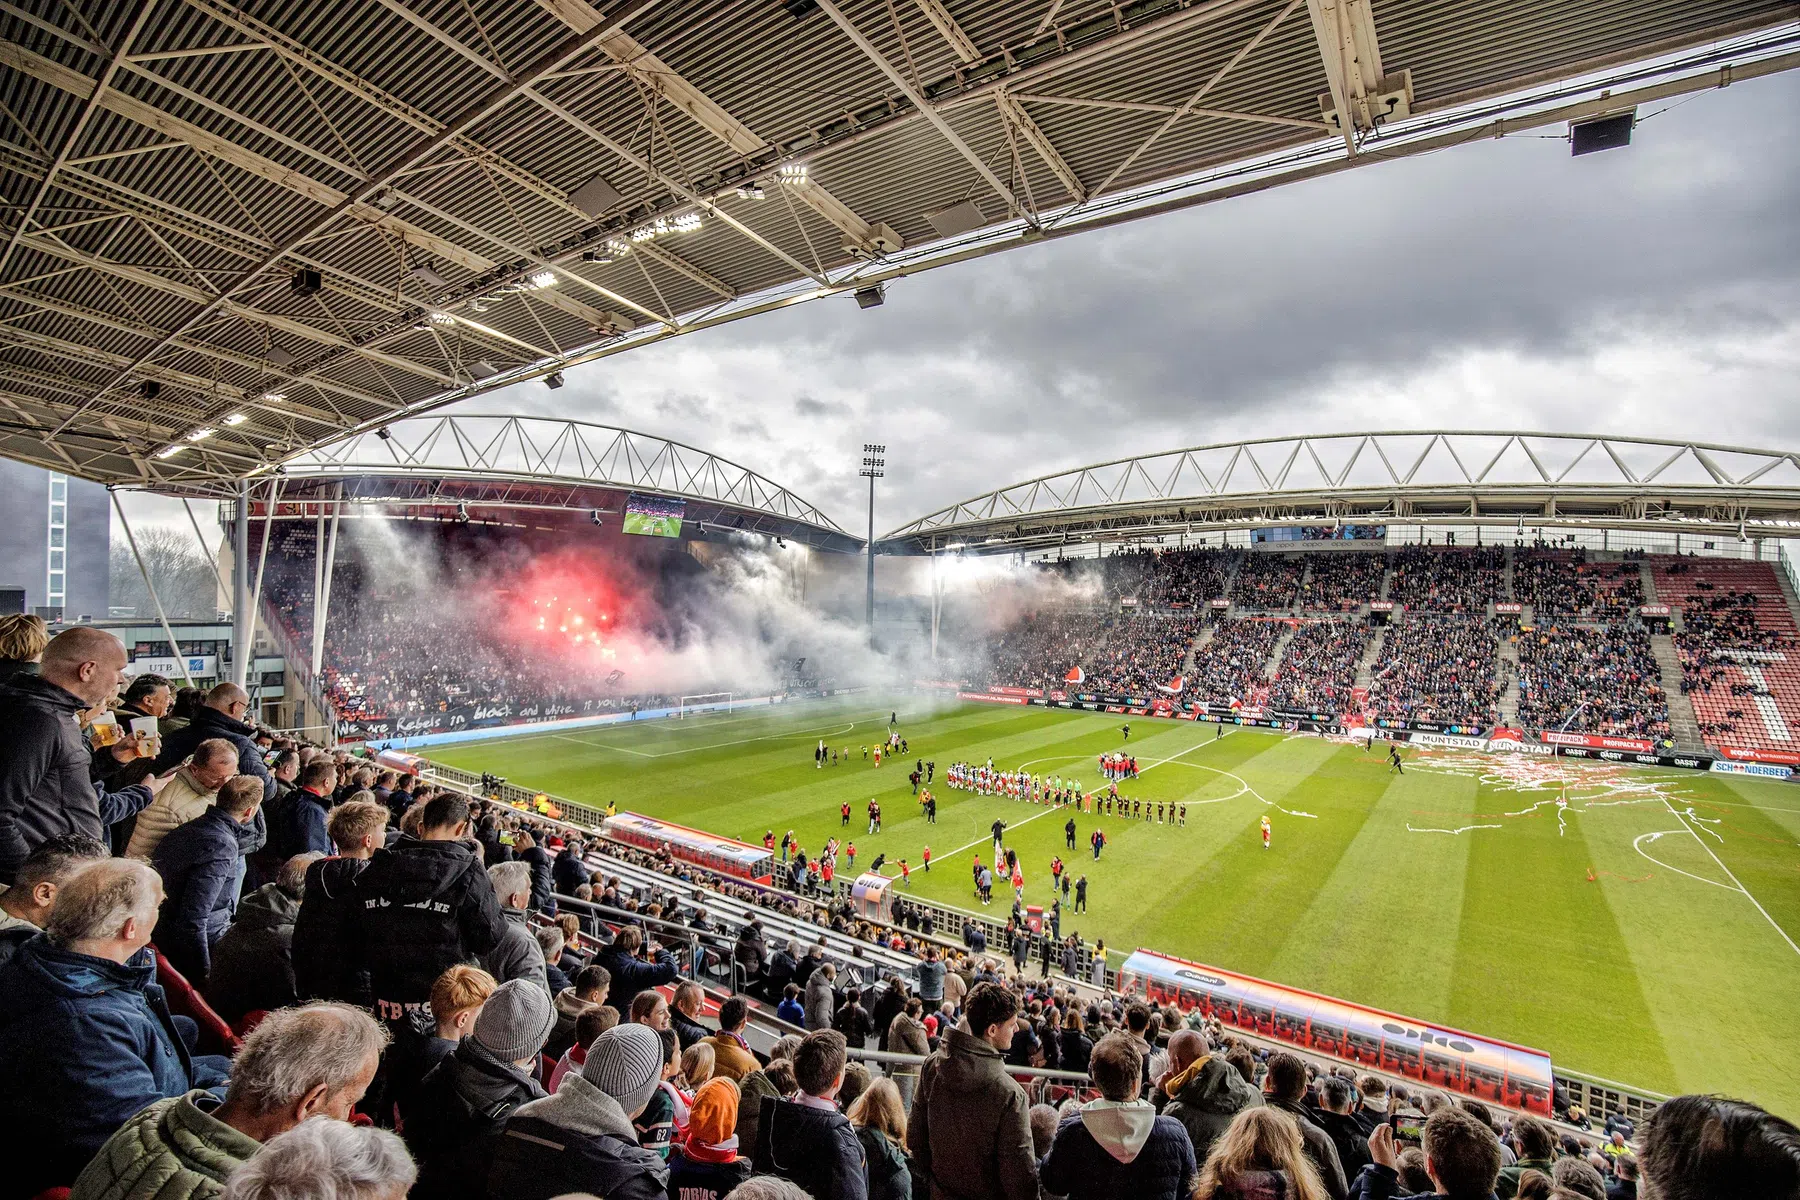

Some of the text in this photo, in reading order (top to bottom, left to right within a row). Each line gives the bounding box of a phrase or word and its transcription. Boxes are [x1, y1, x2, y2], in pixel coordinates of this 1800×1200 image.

[149, 664, 173, 672] UTB
[367, 723, 389, 734] are
[396, 716, 441, 731] Rebels
[473, 703, 512, 720] black
[519, 703, 539, 717] and
[1422, 735, 1480, 747] MUNTSTAD
[1602, 739, 1645, 749] PROFIPACK.NL
[1730, 749, 1755, 757] KOOT
[1184, 971, 1218, 984] Odido.nl
[656, 1129, 667, 1141] 62
